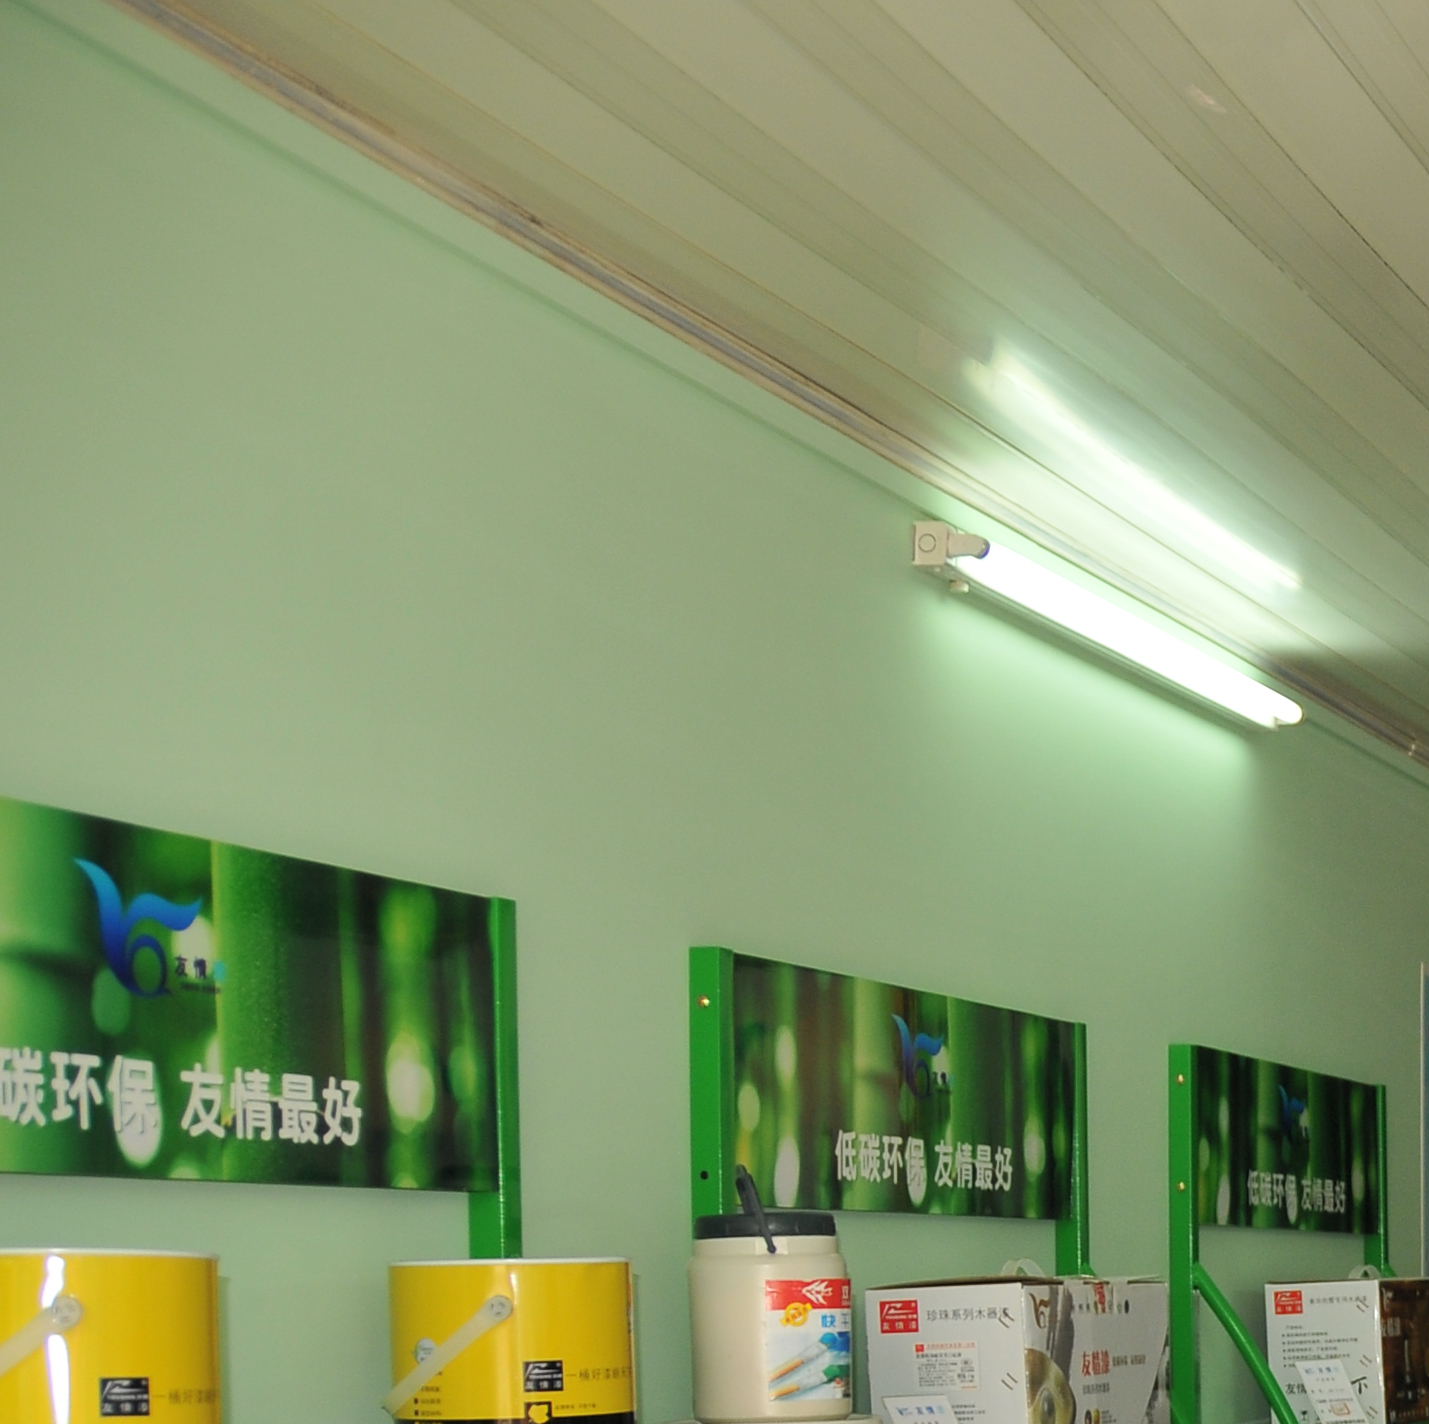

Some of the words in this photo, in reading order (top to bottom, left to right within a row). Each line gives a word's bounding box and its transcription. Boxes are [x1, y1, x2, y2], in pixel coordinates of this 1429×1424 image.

[180, 1062, 363, 1148] 友情最好
[835, 1130, 927, 1187] 低碳环保
[934, 1139, 1013, 1192] 友情最好
